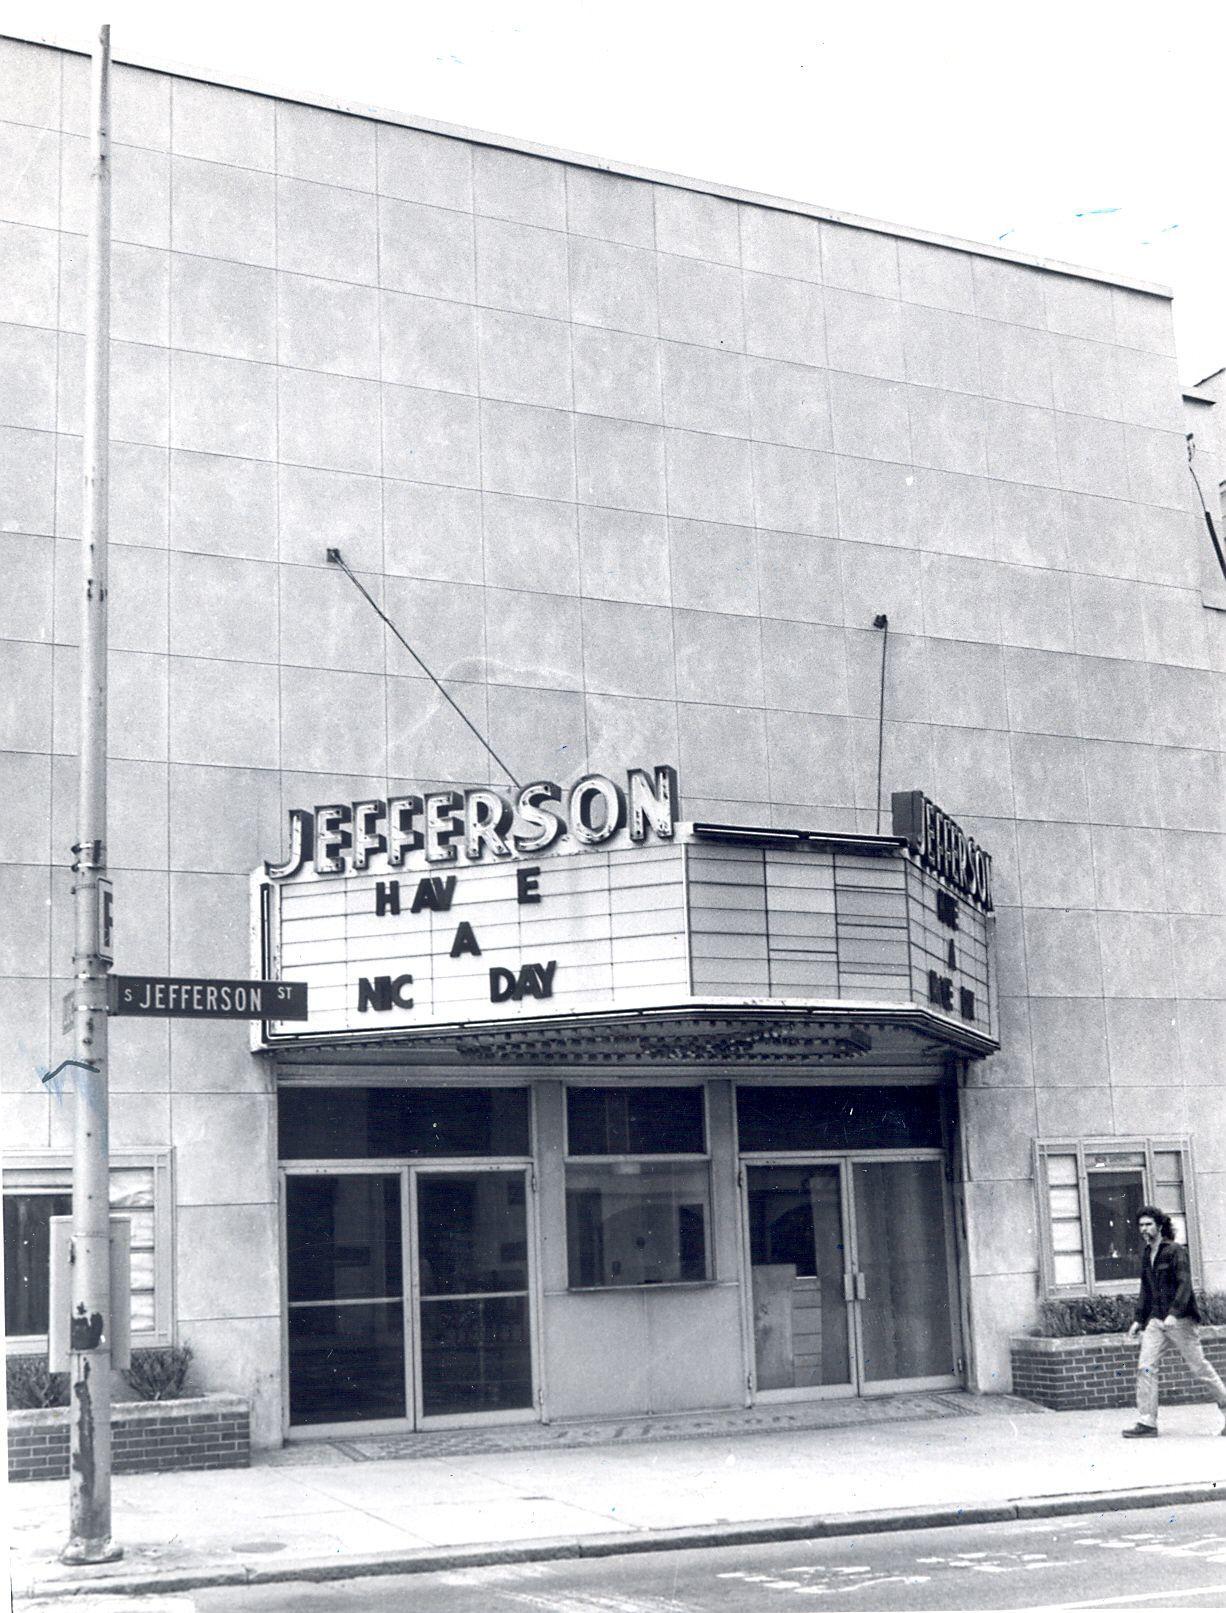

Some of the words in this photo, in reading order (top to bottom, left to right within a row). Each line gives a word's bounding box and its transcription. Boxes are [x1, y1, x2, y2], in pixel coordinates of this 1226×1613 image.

[264, 764, 680, 879] JEFFERSON
[449, 921, 482, 958] A
[124, 988, 133, 1003] S
[139, 984, 262, 1012] JEFFERSON
[276, 986, 293, 1000] ST
[489, 960, 557, 1003] DAY
